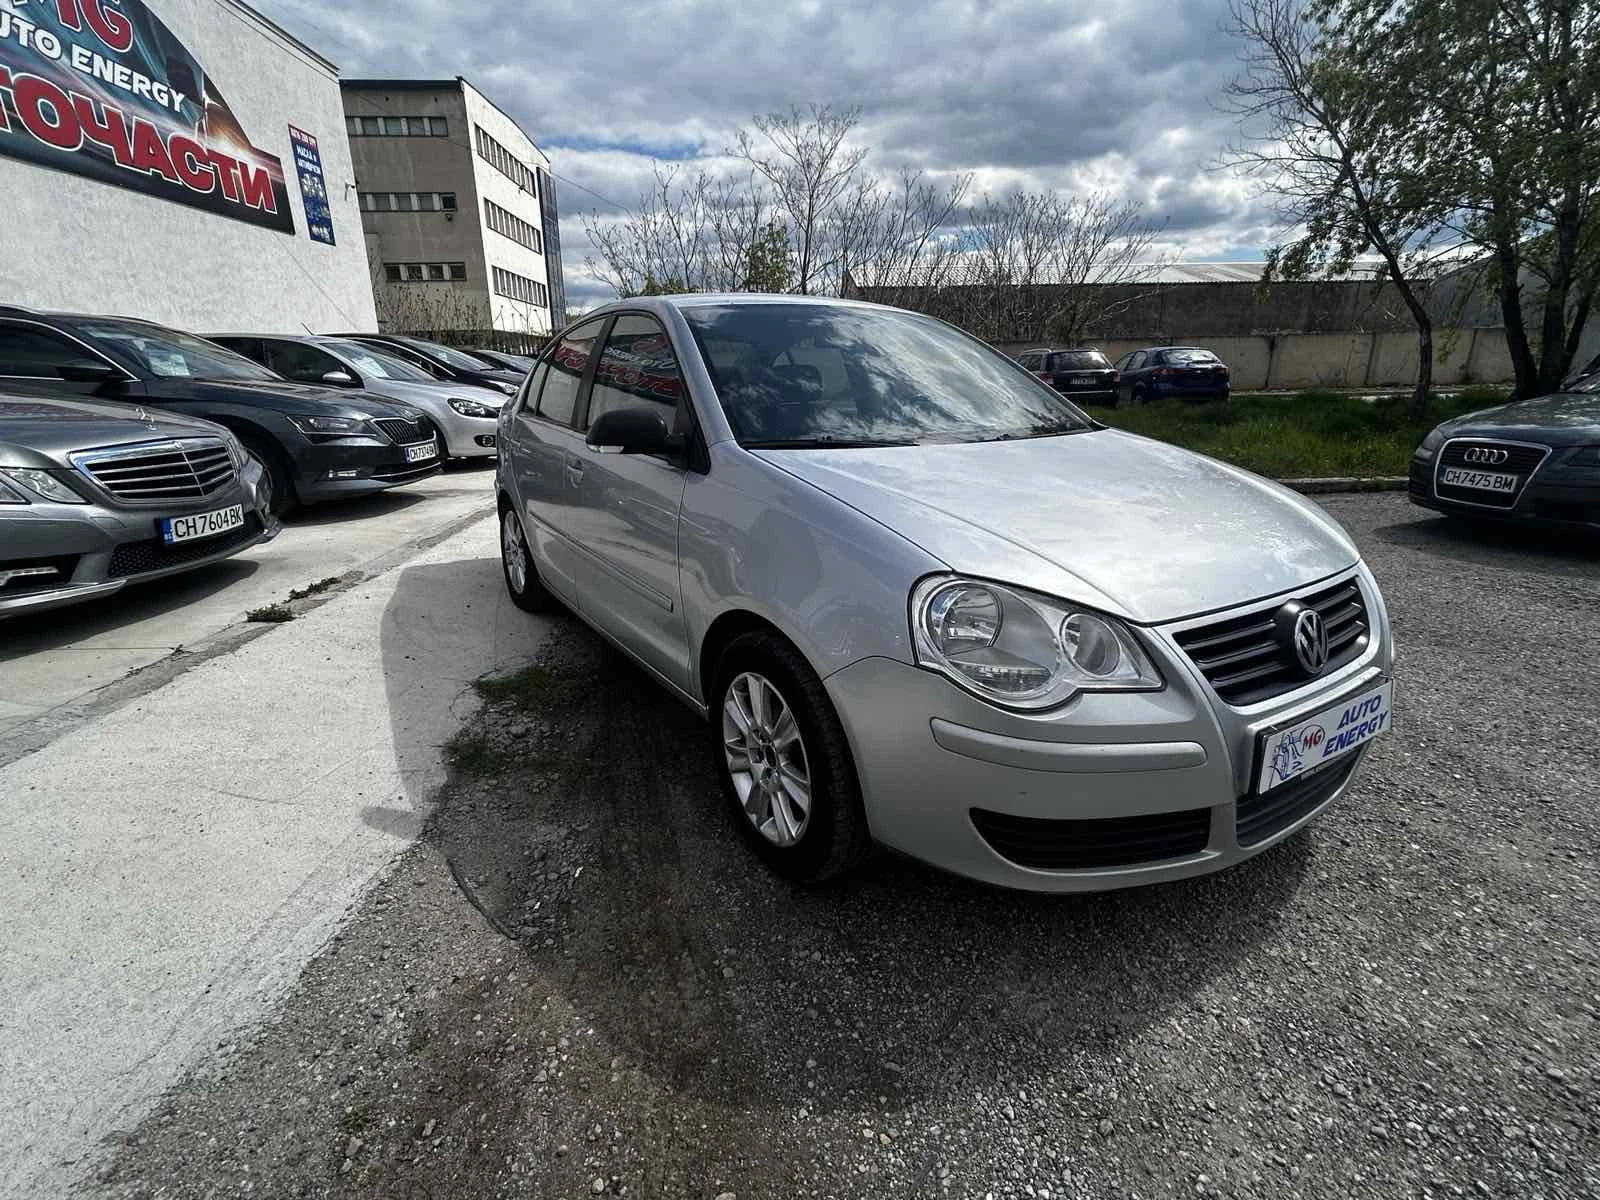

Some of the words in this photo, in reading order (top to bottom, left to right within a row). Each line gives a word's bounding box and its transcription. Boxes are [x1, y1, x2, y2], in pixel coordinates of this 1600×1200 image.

[71, 43, 185, 112] ENERGY
[0, 65, 278, 214] ОЧАСТИ
[1322, 710, 1388, 757] ENERGY
[1337, 694, 1382, 730] AUTO
[1302, 729, 1323, 750] MG
